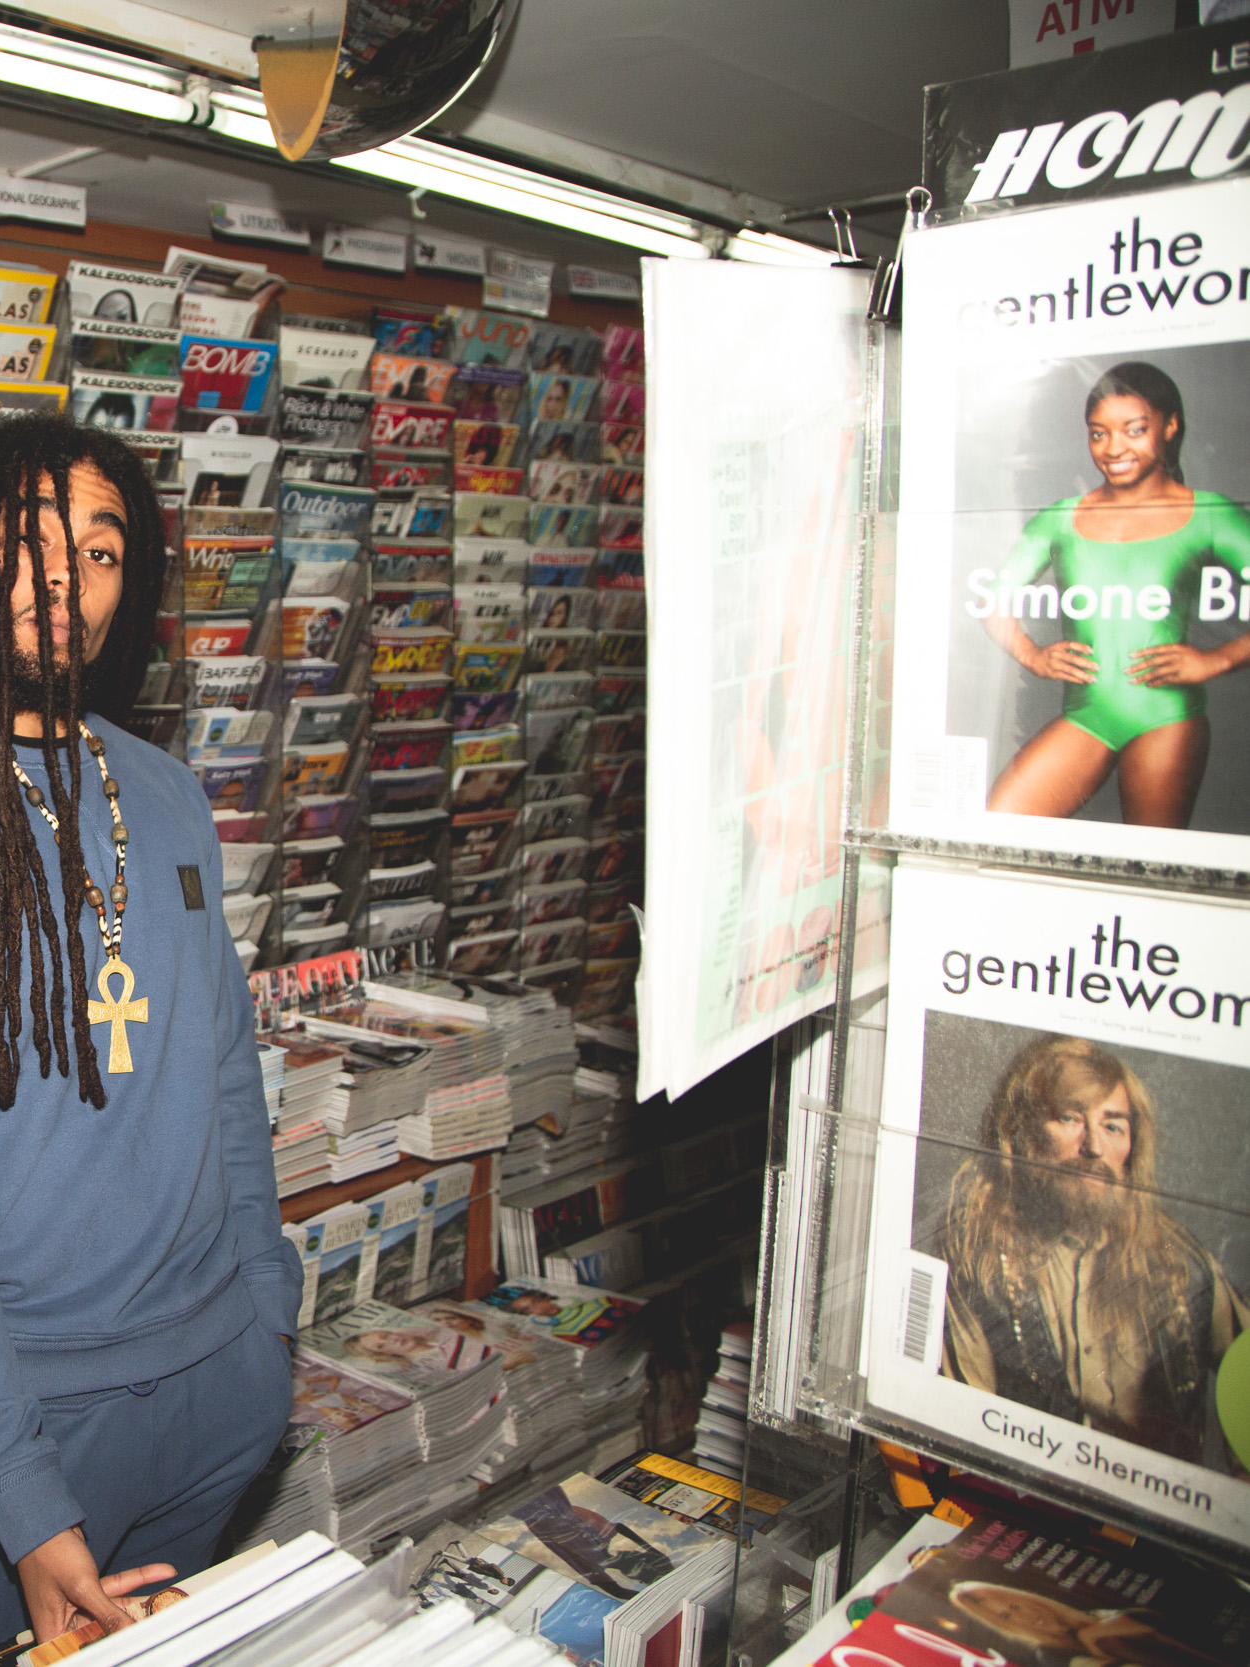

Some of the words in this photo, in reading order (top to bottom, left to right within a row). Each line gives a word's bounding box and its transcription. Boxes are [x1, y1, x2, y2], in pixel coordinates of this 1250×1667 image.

[1036, 0, 1136, 43] ATM
[27, 193, 81, 211] GEOGRAPHIC
[1110, 216, 1203, 276] the
[78, 266, 179, 290] KALEIDOSCOPE
[79, 321, 178, 342] KALEIDOSCOPE
[181, 343, 272, 377] BOMB
[80, 375, 178, 393] KALEIDOSCOPE
[964, 567, 1172, 621] Simone
[1091, 915, 1180, 977] the
[981, 1408, 1063, 1460] Cindy
[1075, 1440, 1213, 1513] Sherman
